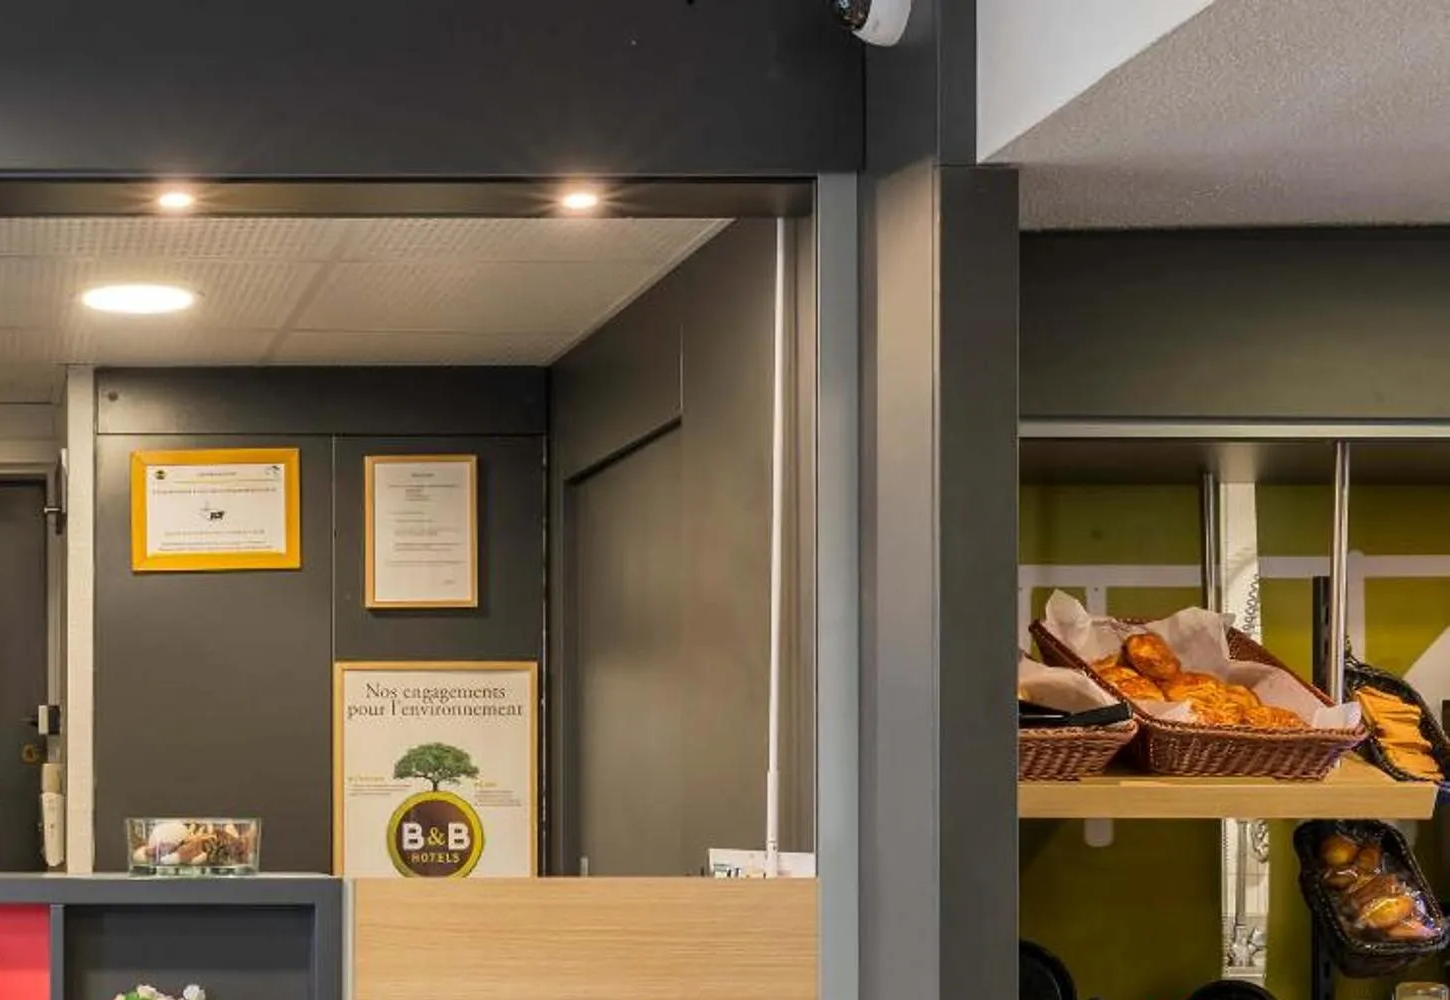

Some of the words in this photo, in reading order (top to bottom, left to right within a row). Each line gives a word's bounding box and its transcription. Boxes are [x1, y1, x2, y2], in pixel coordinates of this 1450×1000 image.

[366, 683, 398, 699] Nos
[403, 686, 506, 705] engagements
[347, 704, 386, 720] pour
[391, 701, 525, 717] l'environnement
[402, 822, 471, 850] B&B
[410, 853, 460, 863] HOTELS
